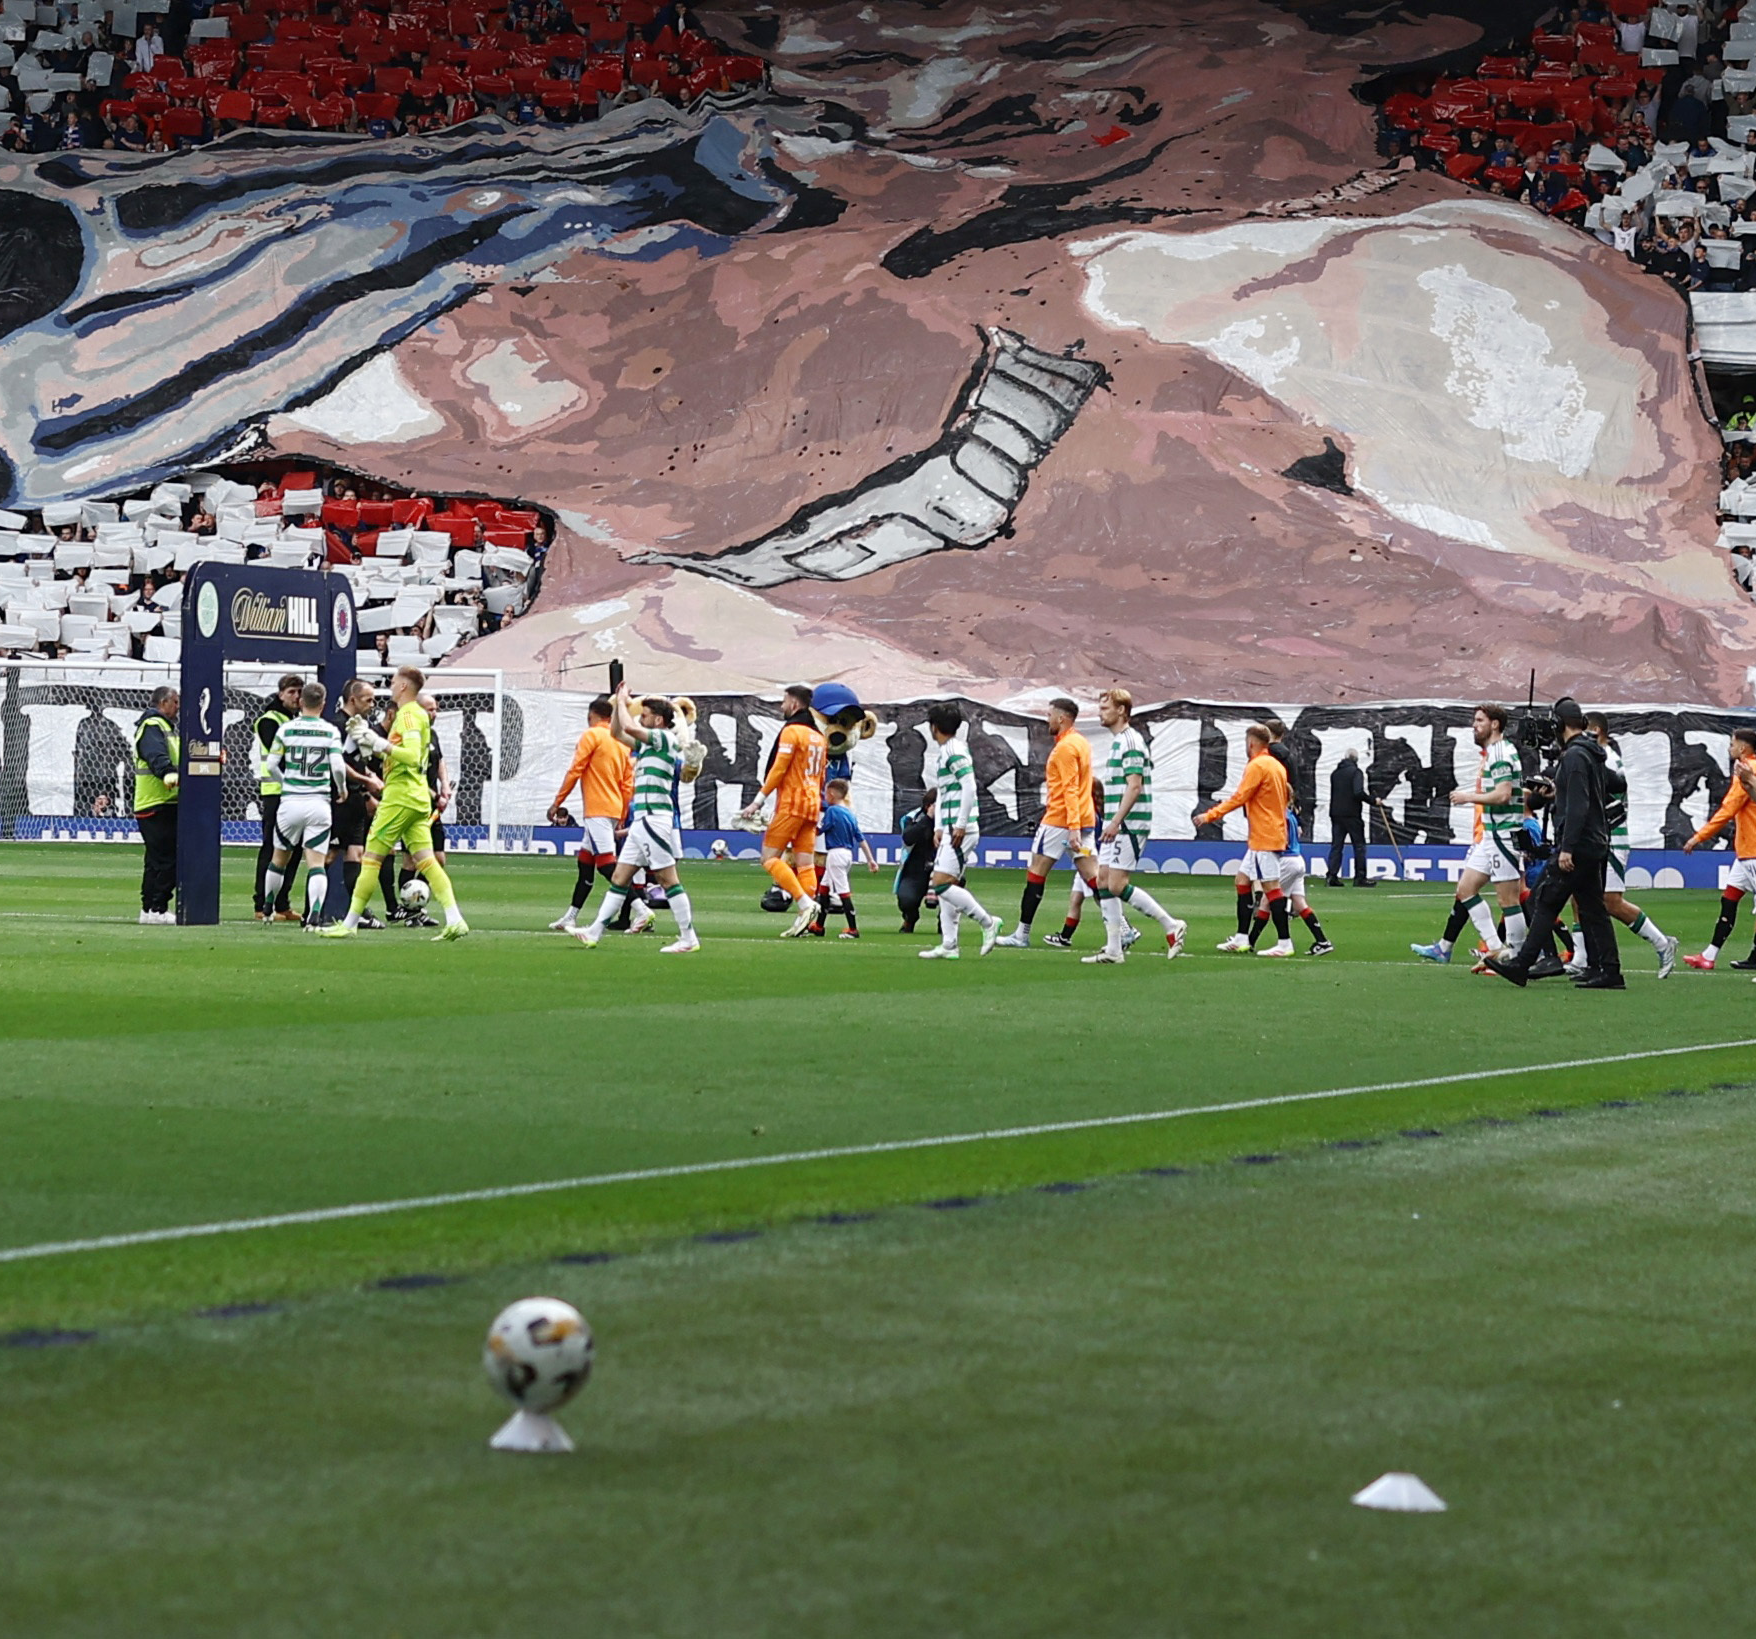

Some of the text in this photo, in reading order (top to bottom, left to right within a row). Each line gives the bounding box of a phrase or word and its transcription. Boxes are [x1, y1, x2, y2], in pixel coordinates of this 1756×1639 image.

[230, 586, 288, 634] William
[287, 596, 320, 635] HILL
[290, 746, 326, 777] 42
[805, 744, 823, 777] 31
